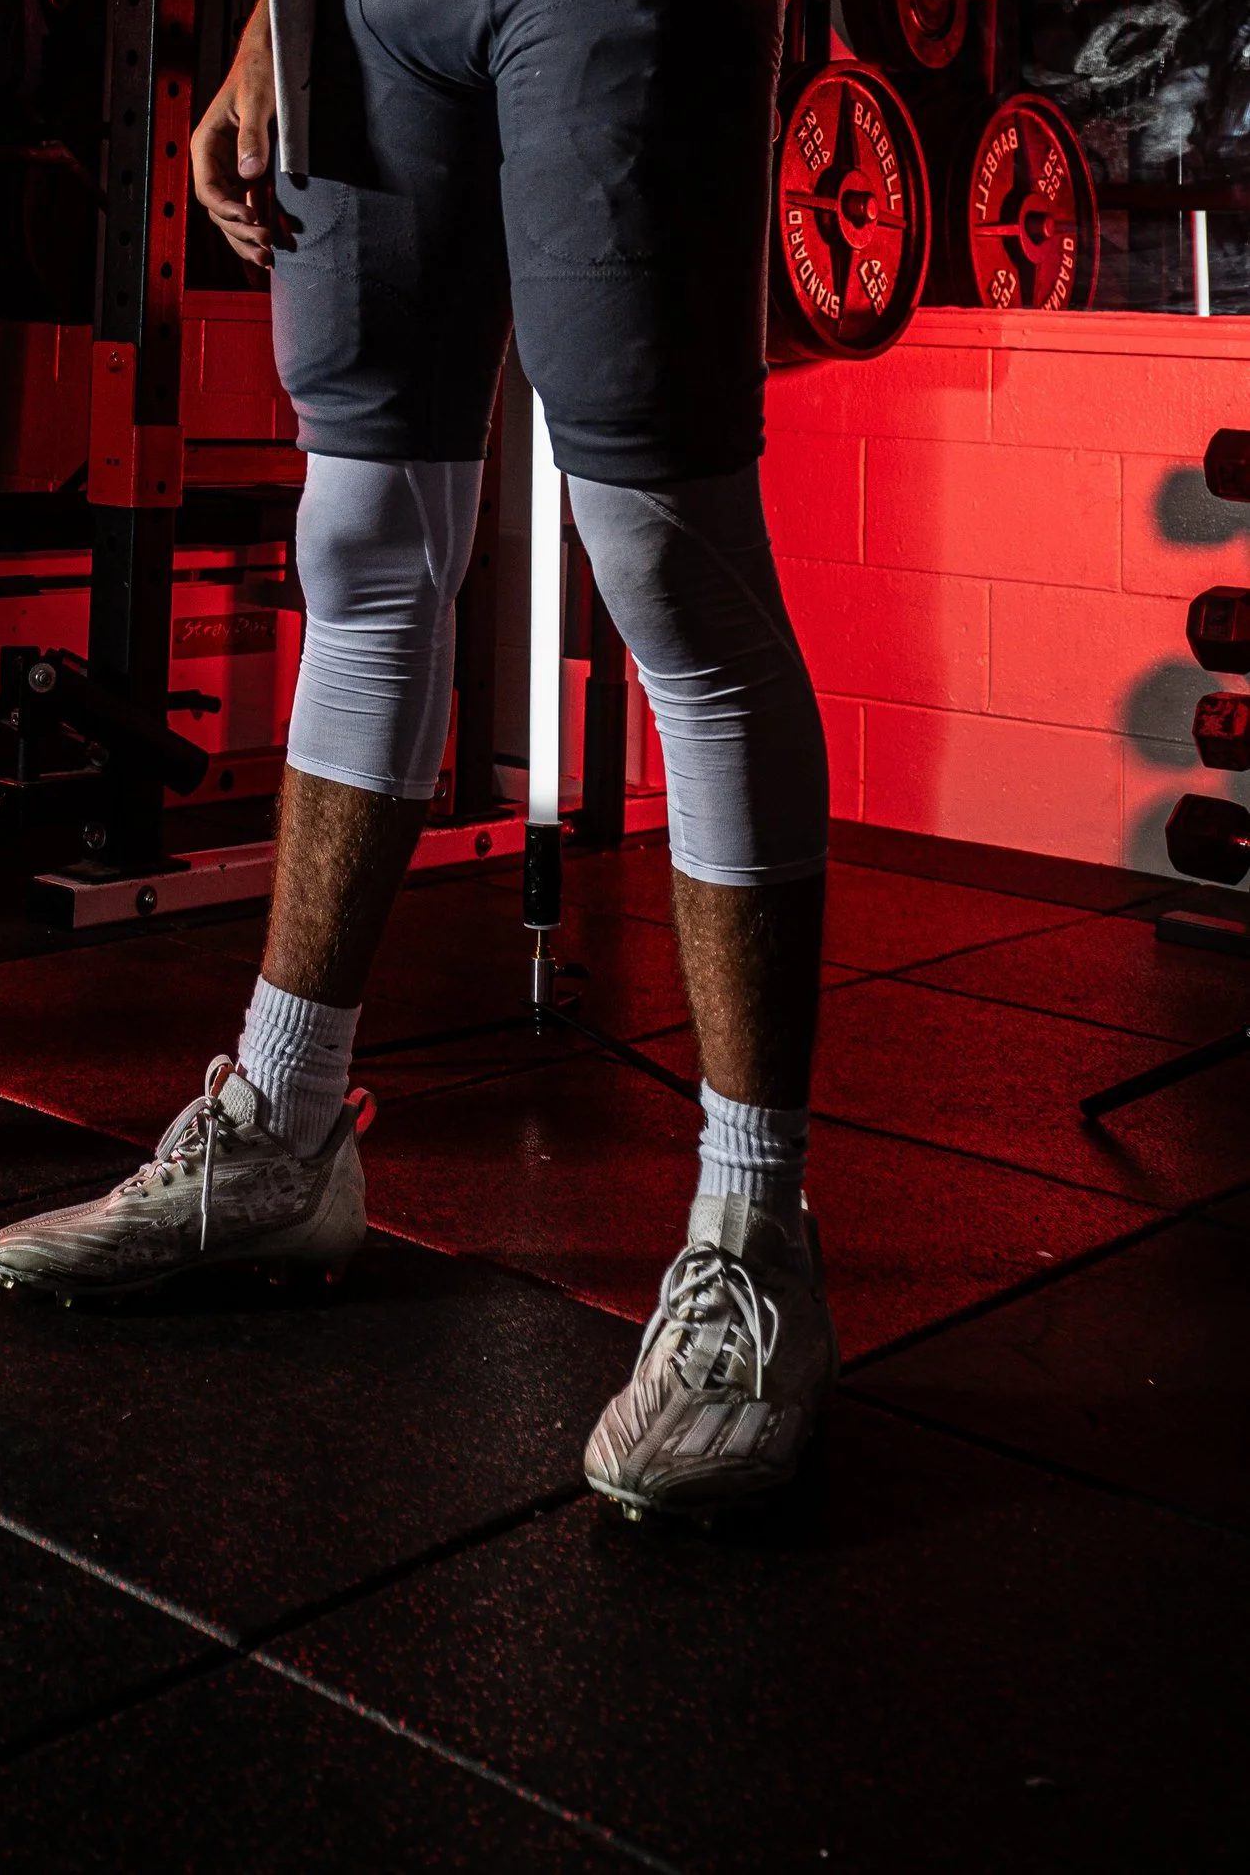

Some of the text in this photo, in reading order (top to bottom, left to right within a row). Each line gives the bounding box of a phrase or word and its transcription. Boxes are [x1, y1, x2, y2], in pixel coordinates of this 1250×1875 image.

[796, 124, 822, 172] KGS
[853, 100, 902, 211] BARBELL
[787, 210, 841, 320] STANDARD
[857, 260, 887, 318] LBS
[869, 258, 889, 294] 45
